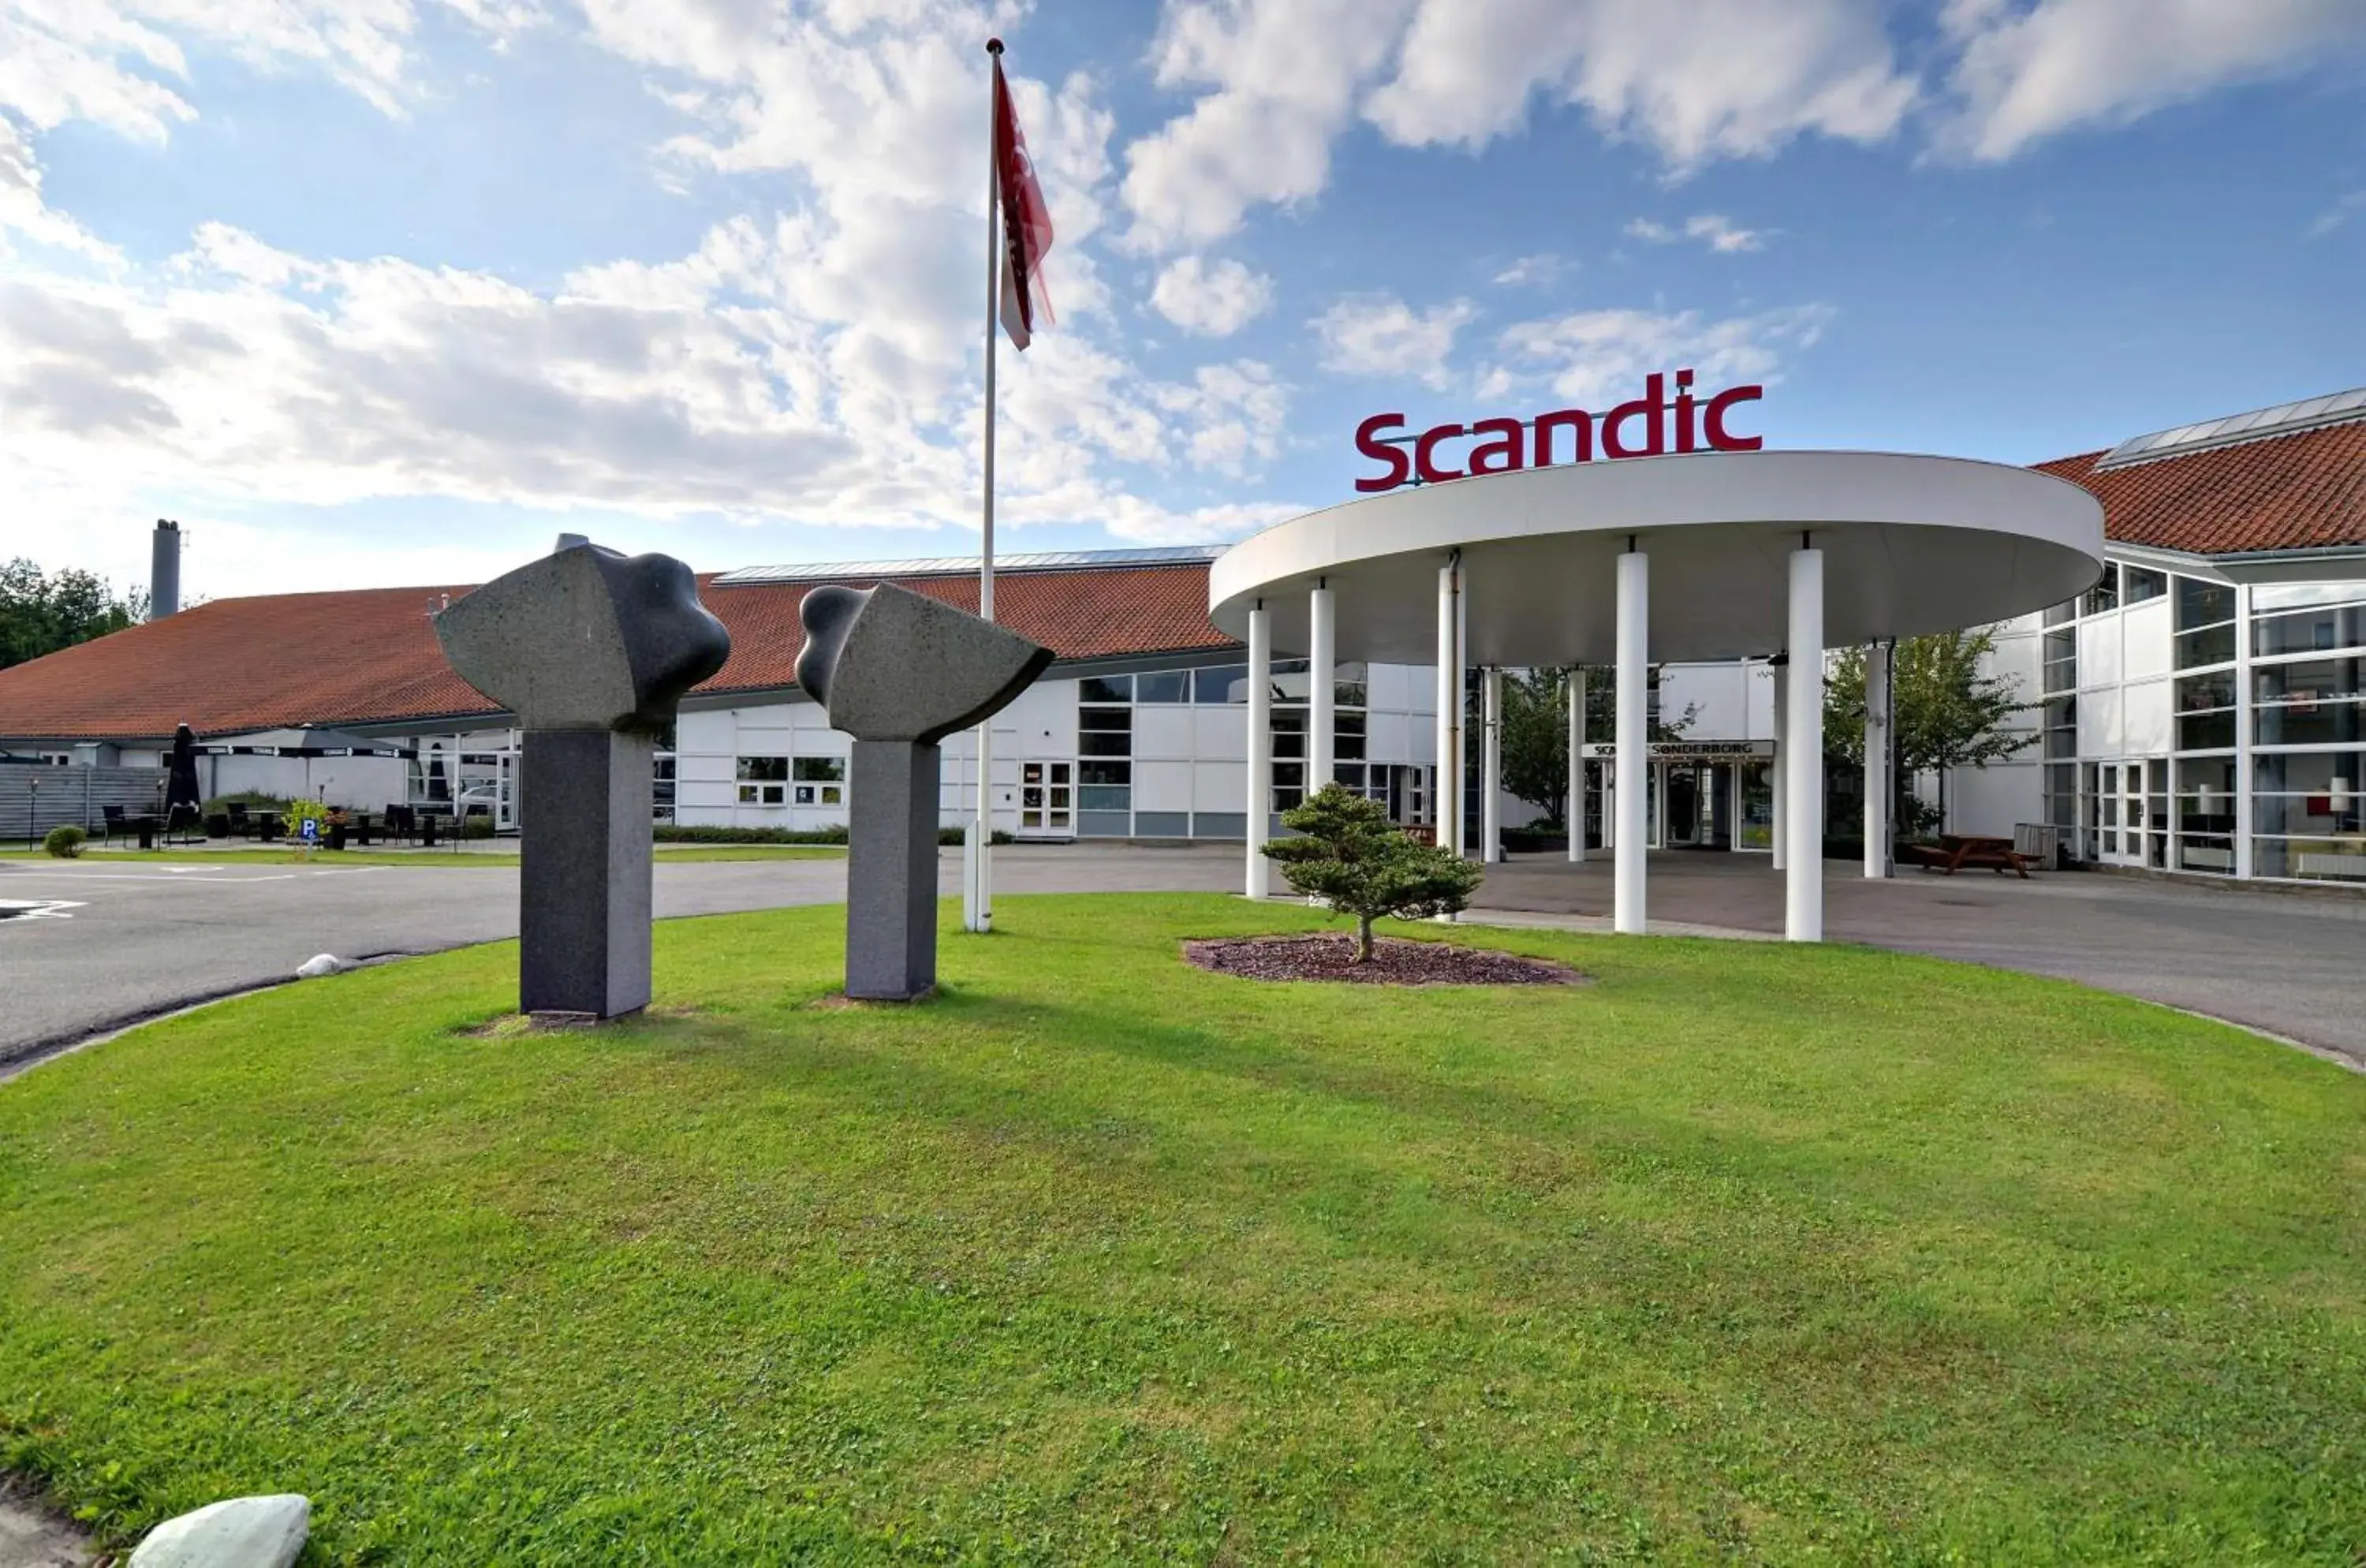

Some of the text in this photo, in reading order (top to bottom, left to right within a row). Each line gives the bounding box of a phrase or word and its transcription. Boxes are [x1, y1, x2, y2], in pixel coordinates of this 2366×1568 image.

[1355, 368, 1763, 492] Scandic
[1594, 743, 1752, 756] SCA SØNDERBORG
[304, 819, 315, 835] P
